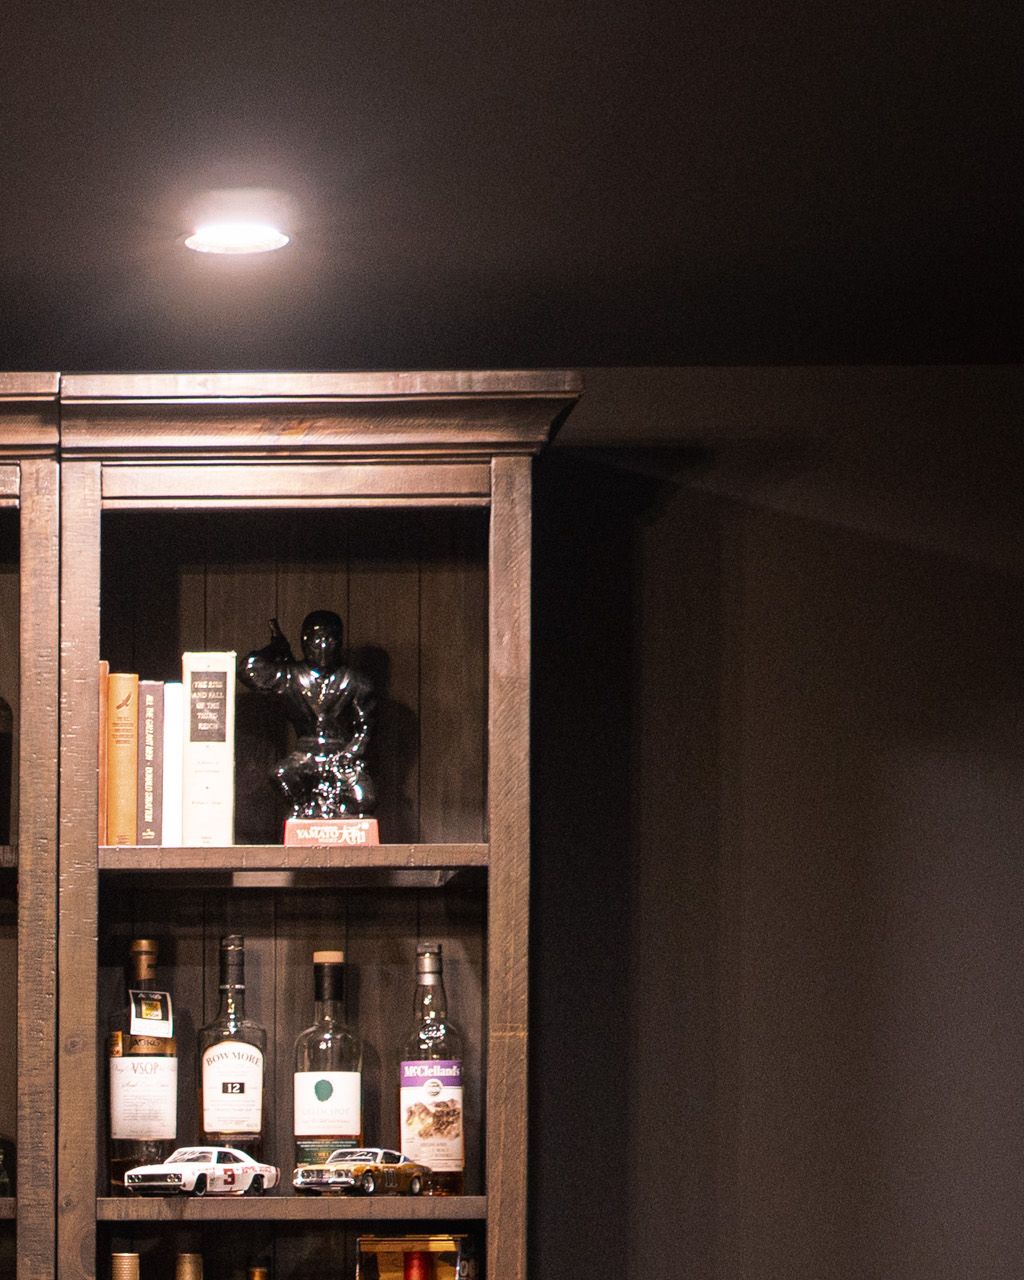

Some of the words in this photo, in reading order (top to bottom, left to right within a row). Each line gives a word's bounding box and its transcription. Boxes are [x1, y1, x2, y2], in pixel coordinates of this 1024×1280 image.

[296, 827, 339, 839] YAMATO
[206, 1051, 261, 1067] BOWMORE
[130, 1062, 160, 1075] VSOP
[404, 1065, 460, 1077] McClelland's
[227, 1084, 240, 1093] 12
[223, 1168, 236, 1185] 3
